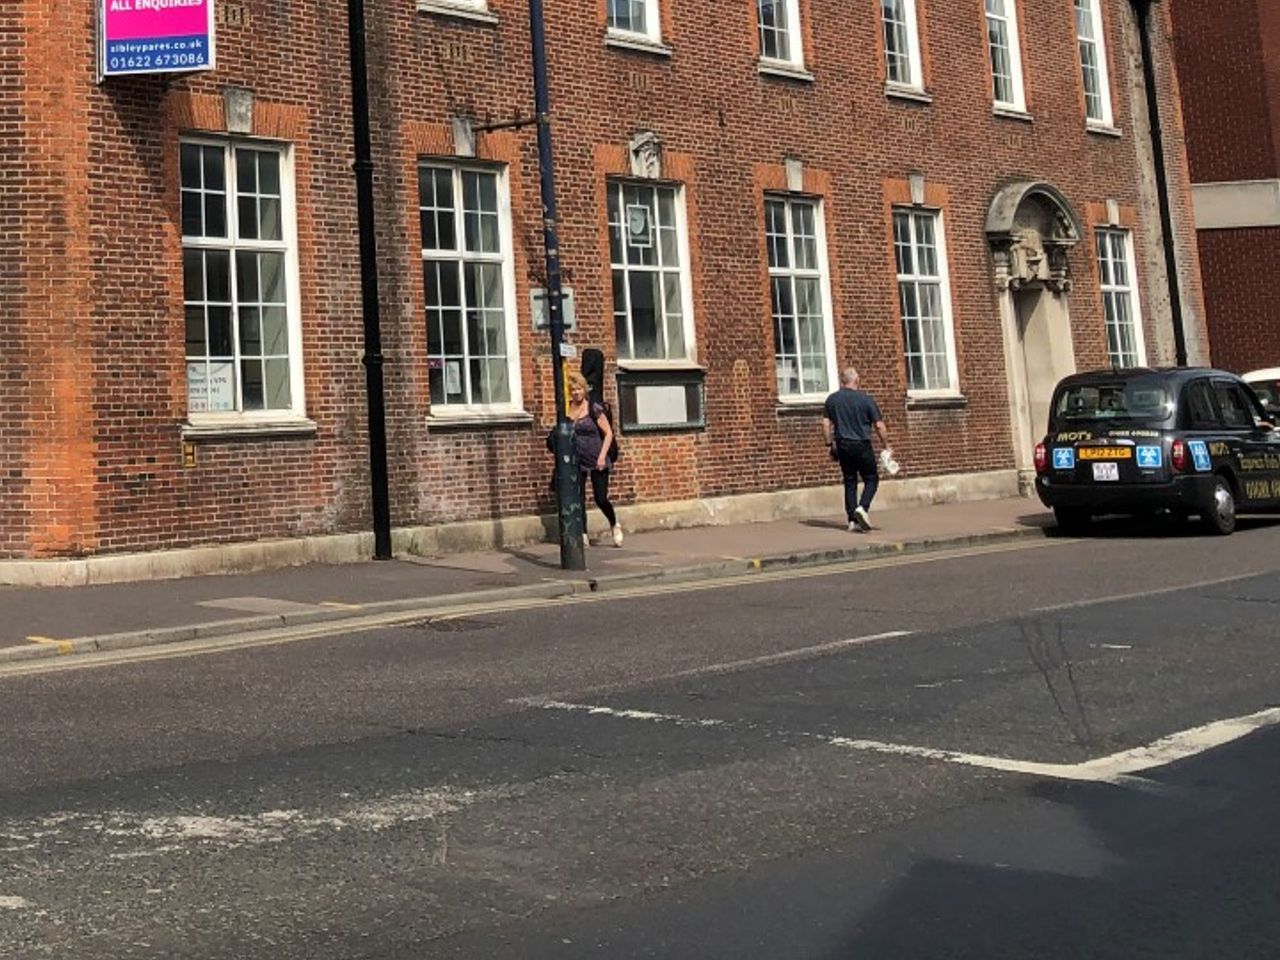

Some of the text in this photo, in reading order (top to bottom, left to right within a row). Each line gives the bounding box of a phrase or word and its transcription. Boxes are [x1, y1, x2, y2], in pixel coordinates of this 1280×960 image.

[110, 0, 132, 12] ALL
[110, 39, 202, 53] sibleypares.co.uk
[110, 52, 205, 69] 01622 673086
